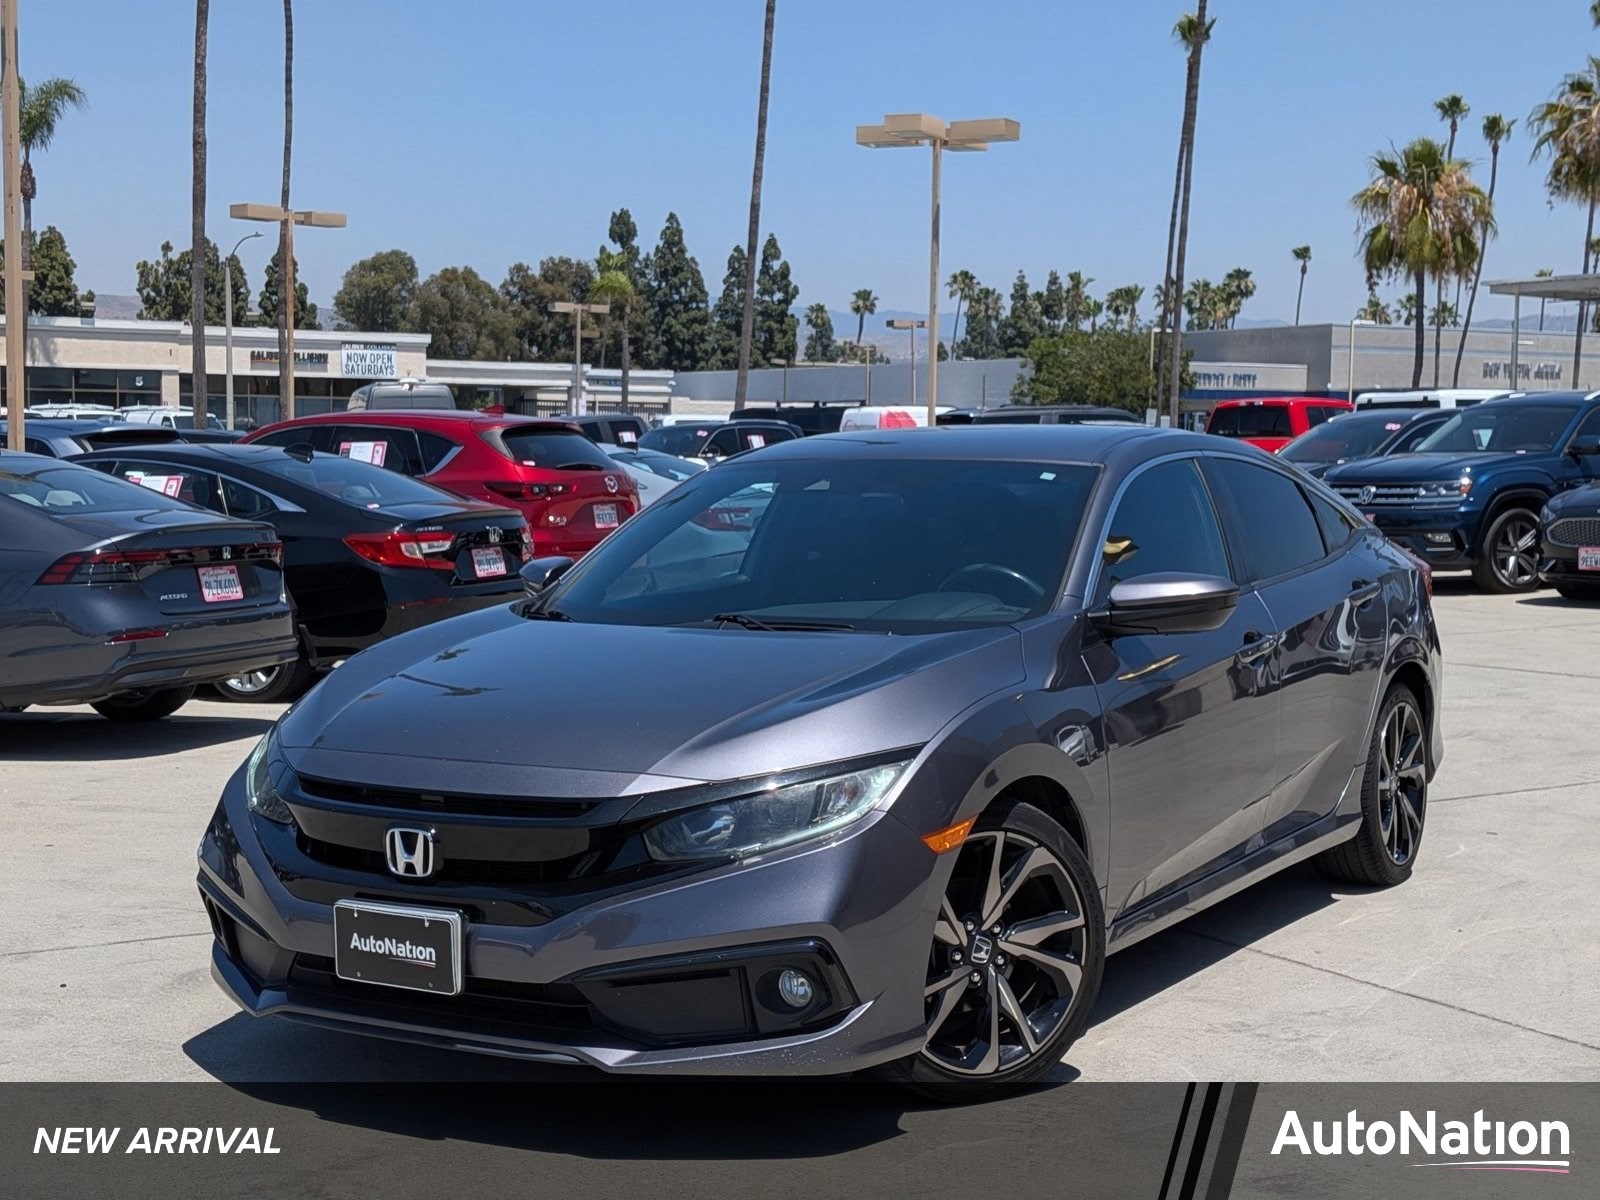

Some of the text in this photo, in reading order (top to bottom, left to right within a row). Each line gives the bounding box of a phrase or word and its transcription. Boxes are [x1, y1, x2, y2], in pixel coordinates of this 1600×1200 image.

[346, 352, 393, 365] NOW OPEN
[345, 363, 395, 376] SATURDAYS
[135, 376, 144, 386] 5
[350, 932, 436, 961] AutoNation
